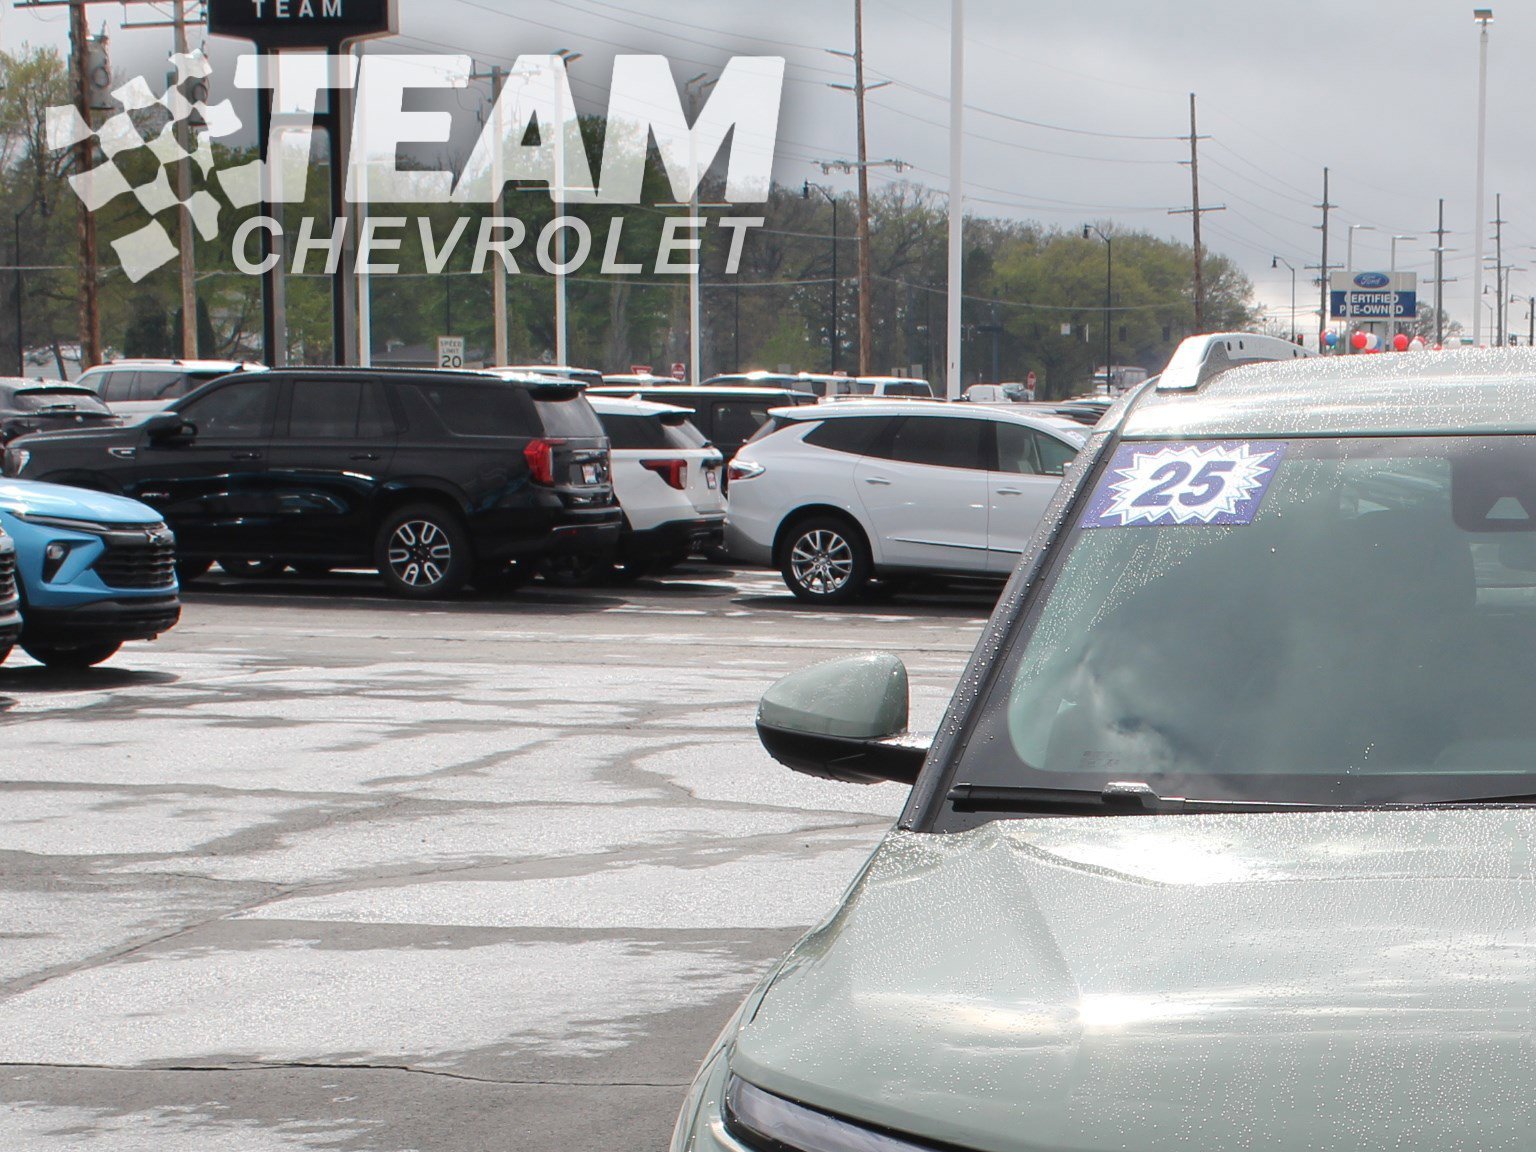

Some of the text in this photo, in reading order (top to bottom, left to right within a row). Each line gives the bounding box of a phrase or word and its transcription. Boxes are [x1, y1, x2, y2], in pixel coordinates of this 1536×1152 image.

[253, 0, 343, 18] TEAM
[1340, 304, 1404, 315] PE-OWND
[441, 355, 462, 368] 20
[1130, 460, 1238, 508] 25
